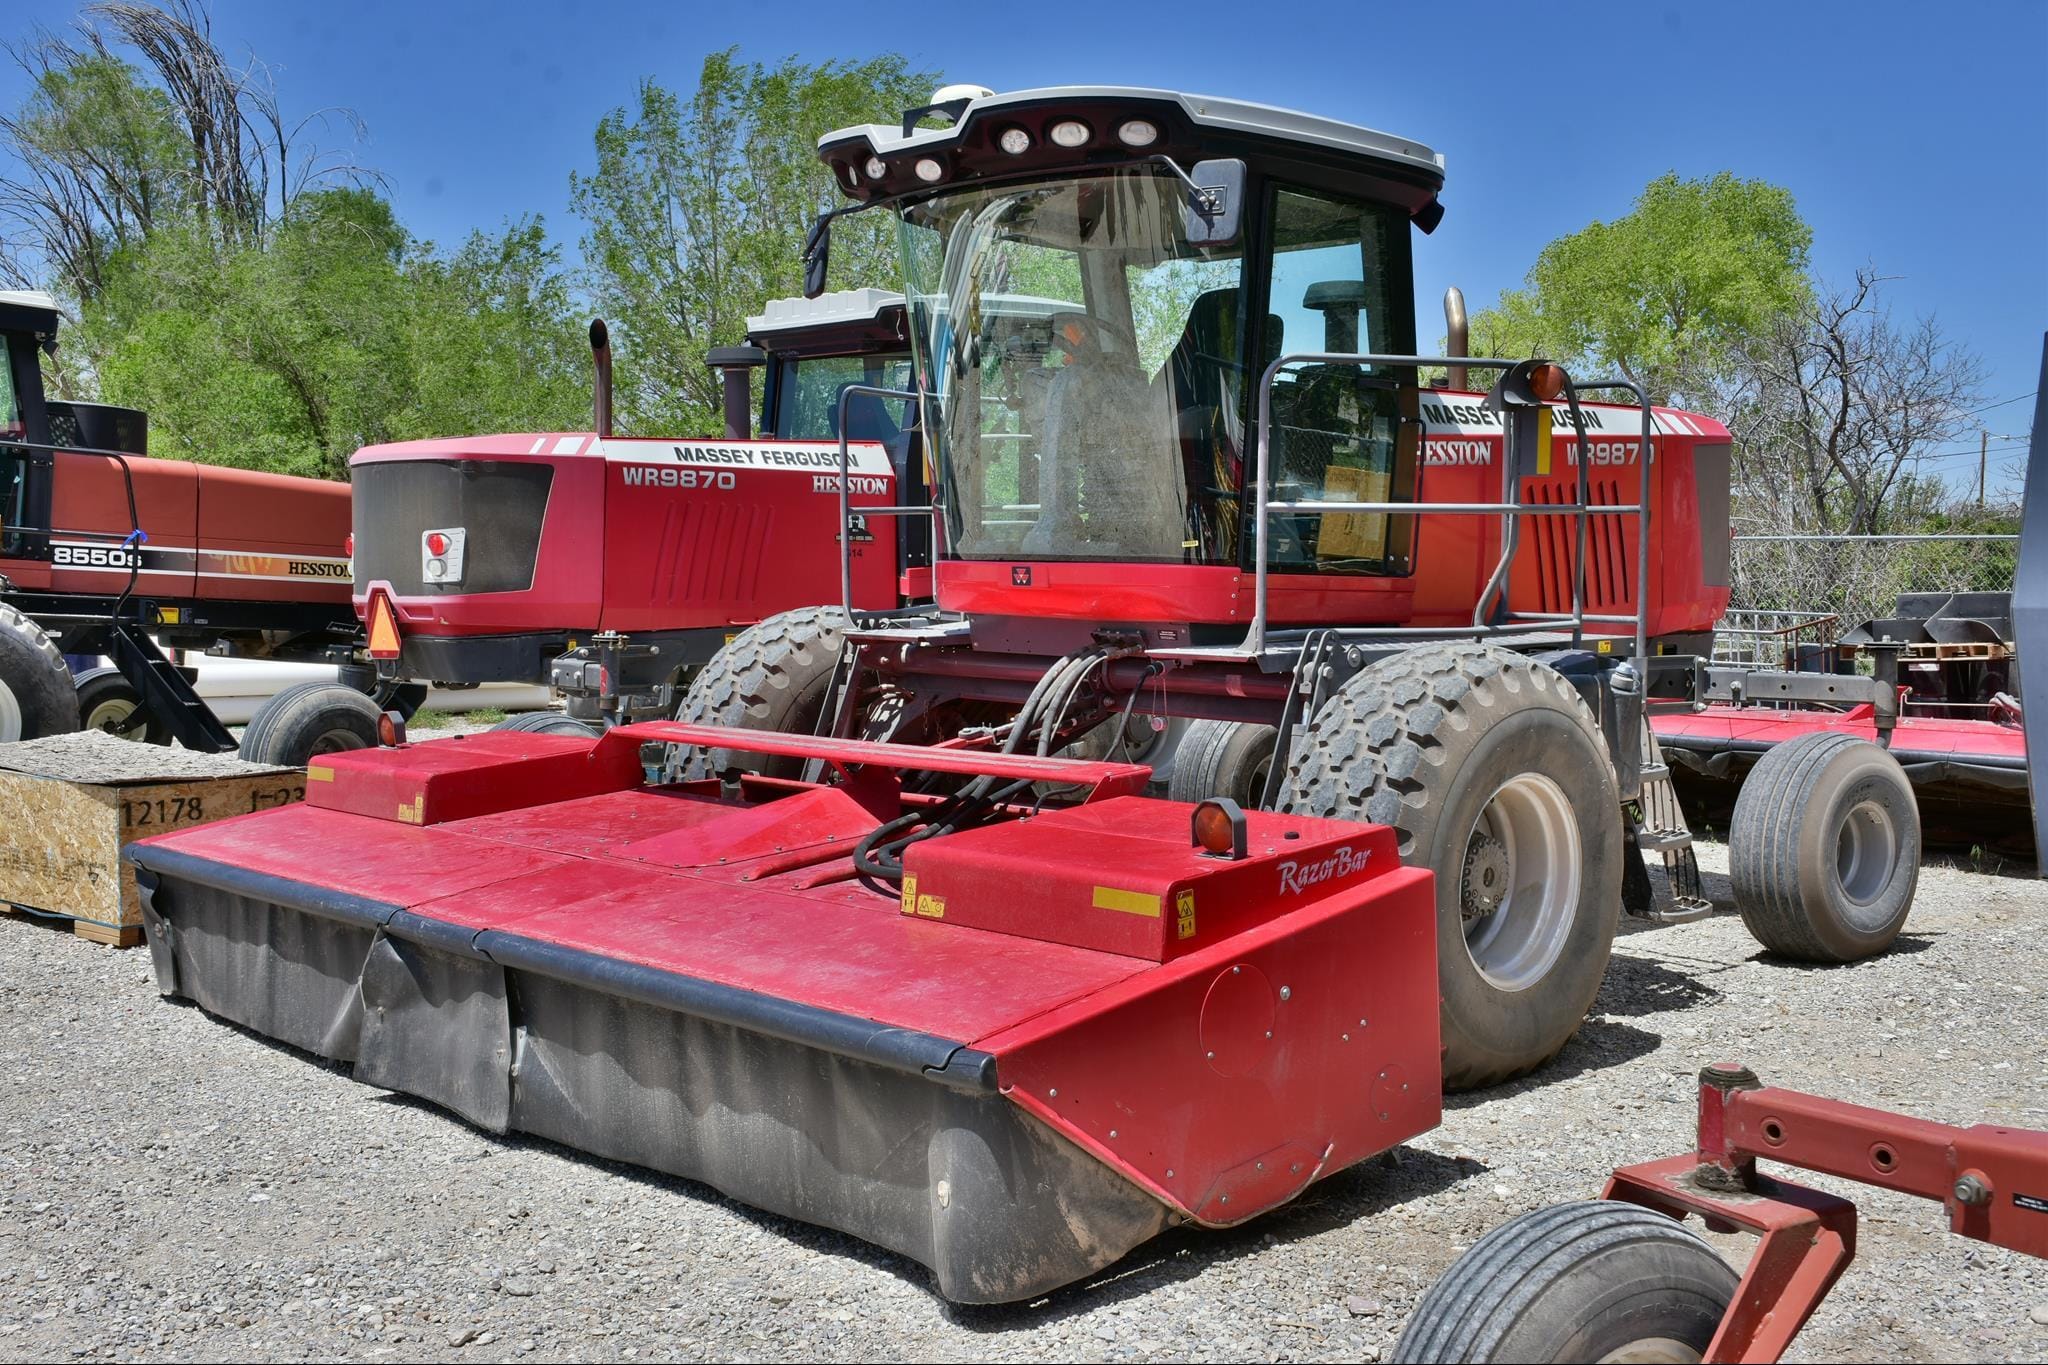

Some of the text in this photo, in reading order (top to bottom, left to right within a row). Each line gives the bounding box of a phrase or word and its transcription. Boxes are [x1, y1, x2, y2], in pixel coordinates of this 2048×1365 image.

[1422, 404, 1504, 426] MASSEY
[673, 446, 860, 468] MASSEY FERGUSON
[622, 466, 736, 490] WR9870
[121, 797, 203, 827] 12178
